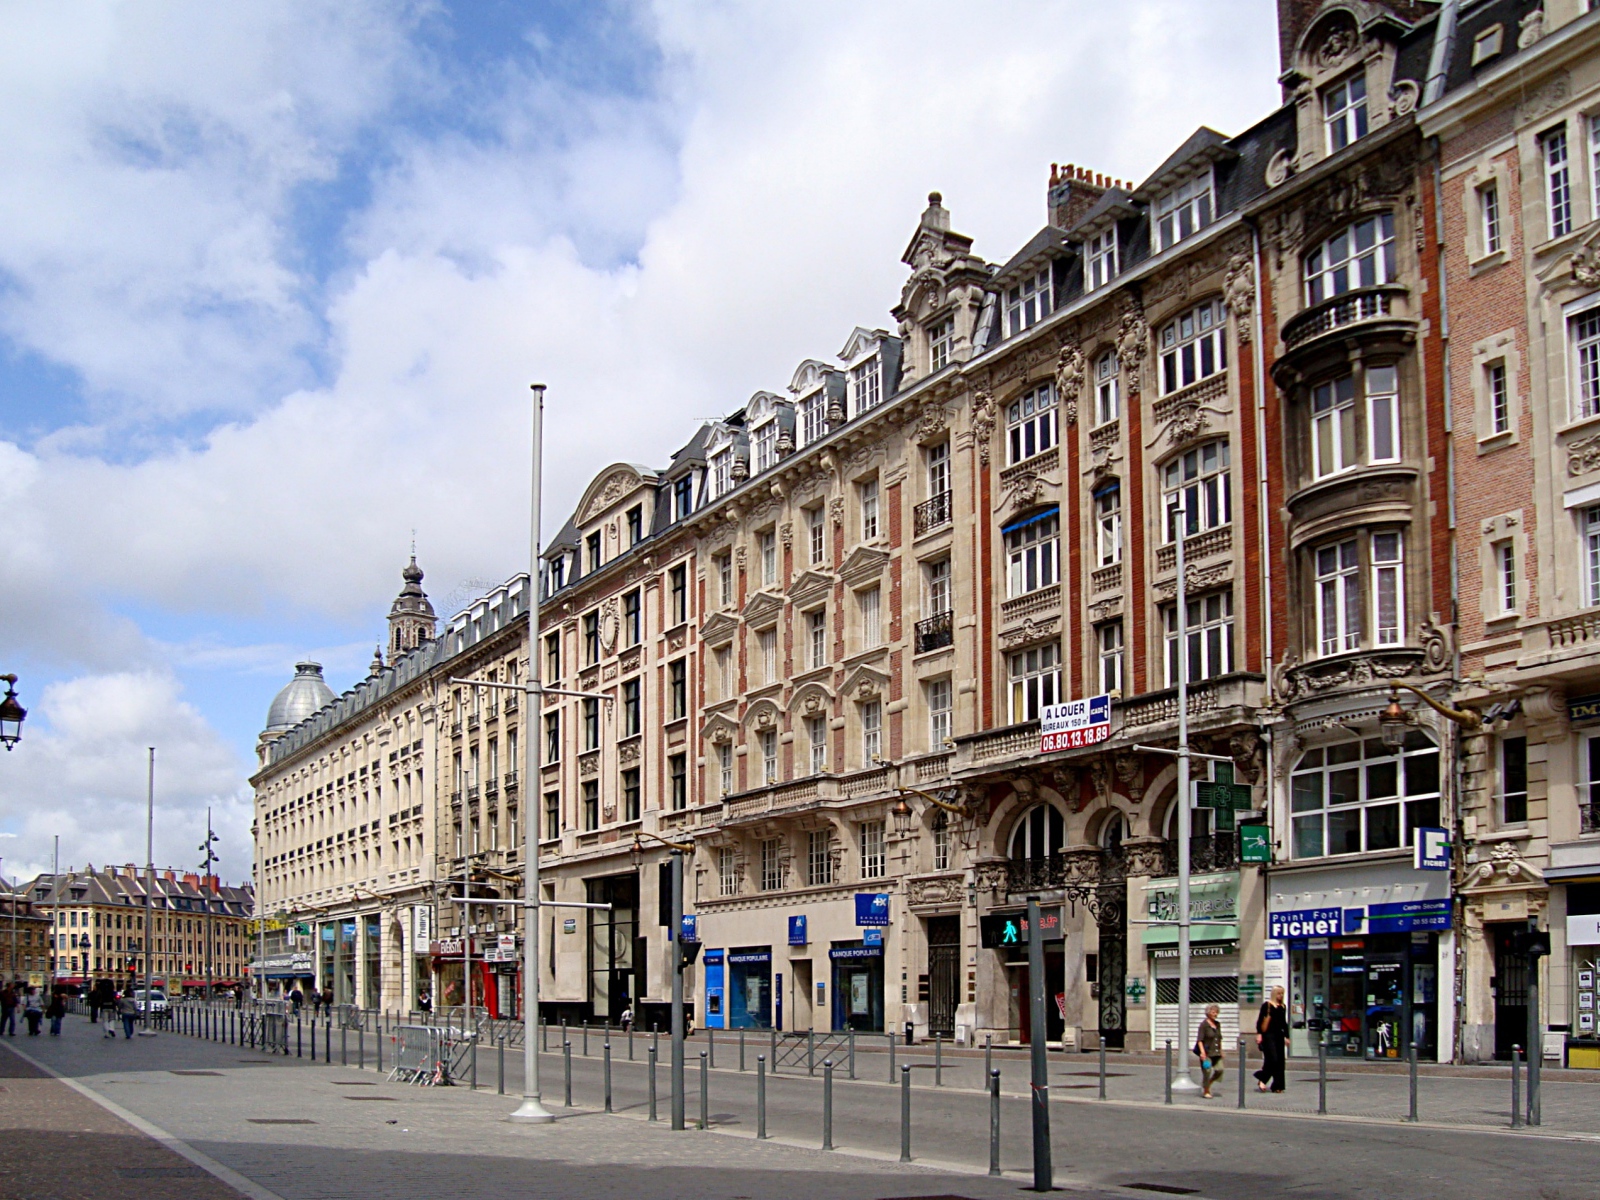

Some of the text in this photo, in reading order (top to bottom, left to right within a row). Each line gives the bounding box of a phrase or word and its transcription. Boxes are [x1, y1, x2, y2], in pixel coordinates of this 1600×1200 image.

[1046, 703, 1085, 720] A LOUER
[1571, 704, 1600, 718] IM
[1042, 720, 1069, 732] BUREAUX
[1071, 719, 1081, 727] 150
[1043, 726, 1107, 751] 06.80.13.18.89
[1273, 911, 1338, 922] Point Fort
[1194, 948, 1223, 956] CASETTA
